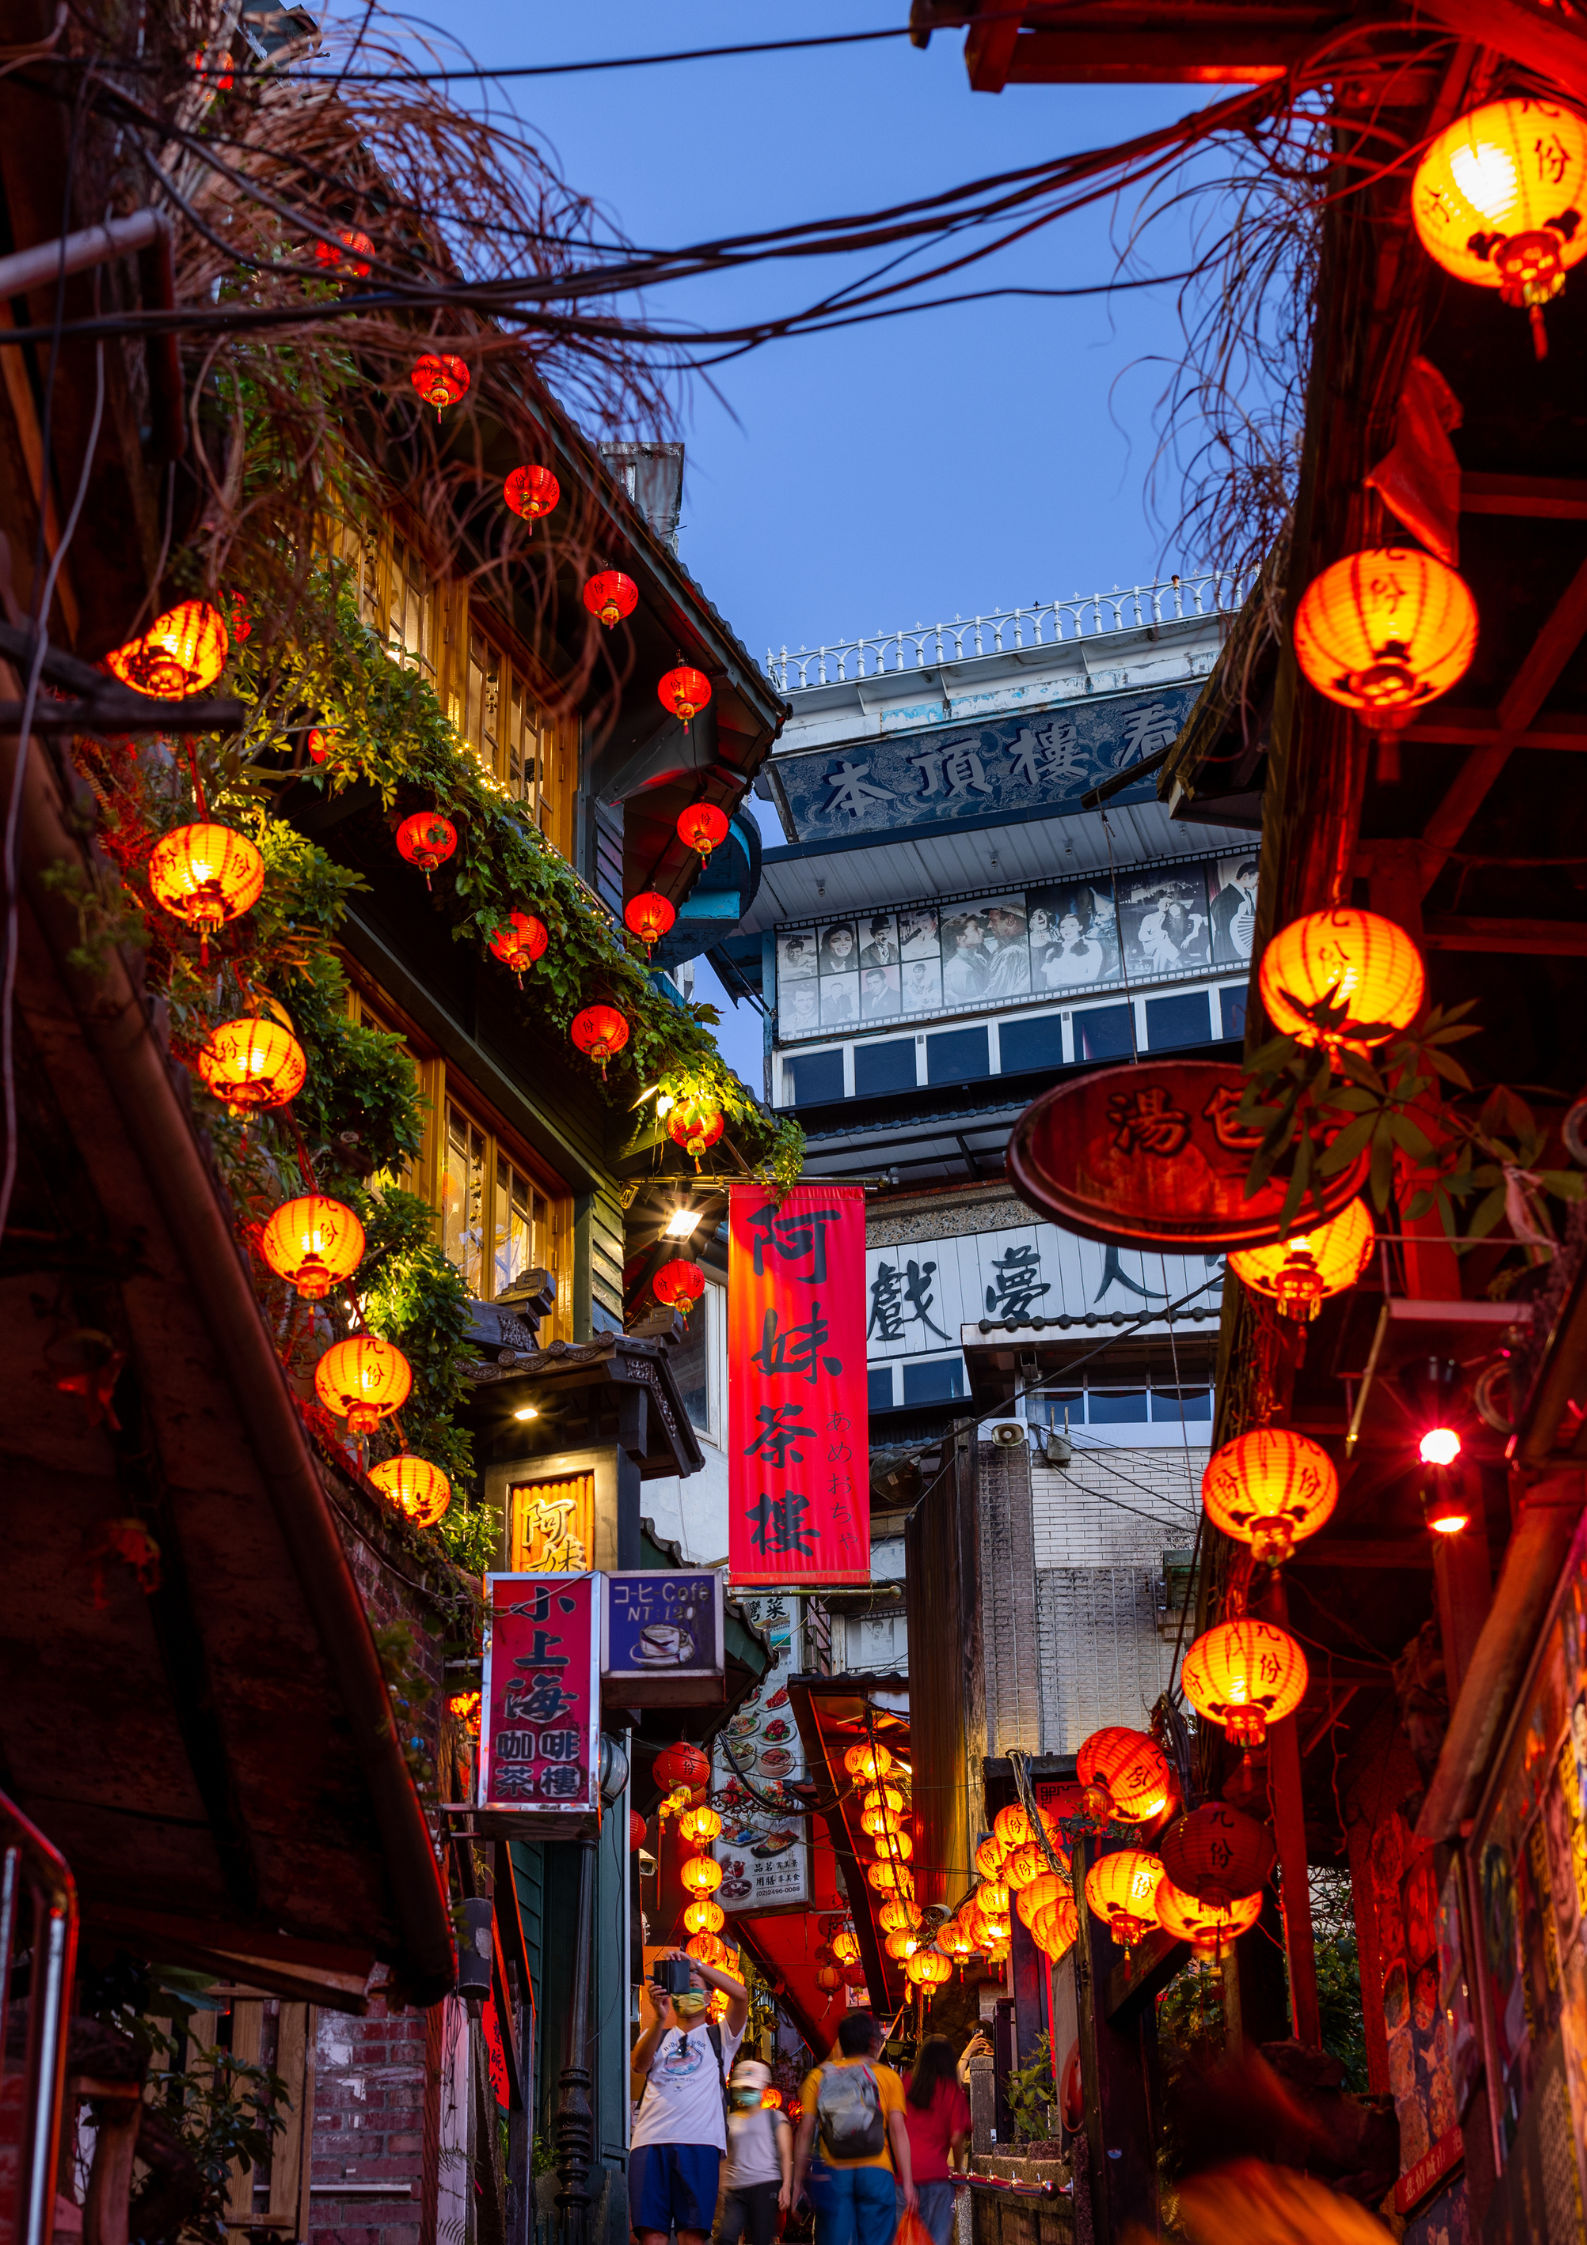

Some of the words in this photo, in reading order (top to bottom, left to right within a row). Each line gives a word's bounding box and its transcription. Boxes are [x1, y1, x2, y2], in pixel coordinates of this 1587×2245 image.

[866, 1245, 1225, 1341] 戲夢人
[746, 1203, 842, 1557] 阿妹茶樓
[826, 1410, 858, 1550] あめおちゃ
[504, 1586, 579, 1724] 小上海
[495, 1765, 581, 1798] 茶樓
[496, 1730, 580, 1762] 咖啡
[1211, 1811, 1236, 1869] 九份
